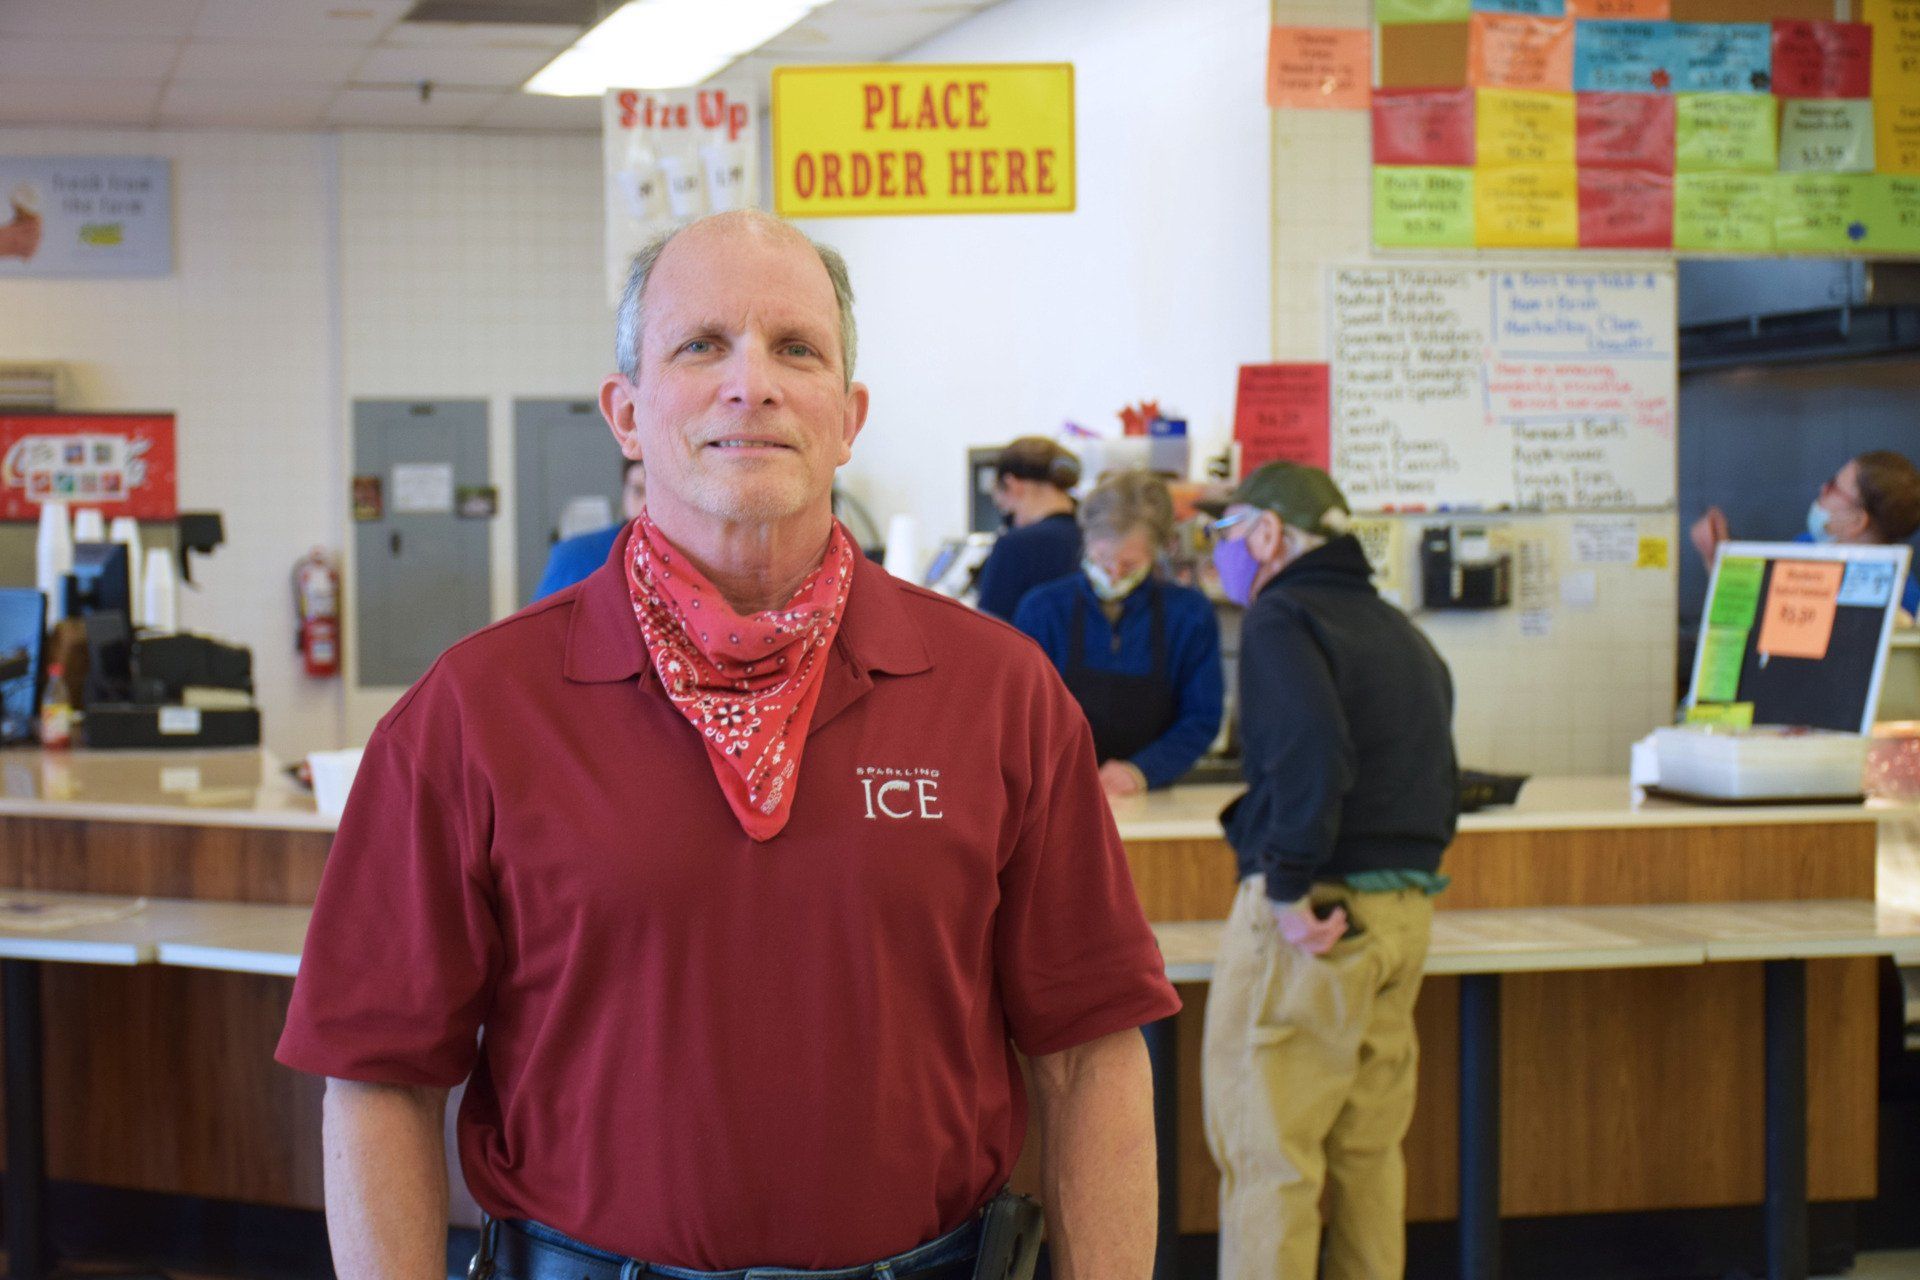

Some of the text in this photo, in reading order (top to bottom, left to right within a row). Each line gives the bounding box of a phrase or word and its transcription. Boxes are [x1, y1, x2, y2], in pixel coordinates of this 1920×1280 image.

[617, 89, 748, 142] Size Up
[863, 82, 989, 130] PLACE
[794, 151, 928, 199] ORDER
[948, 148, 1056, 196] HERE
[856, 766, 940, 778] SPARKLING
[861, 779, 943, 819] ICE
